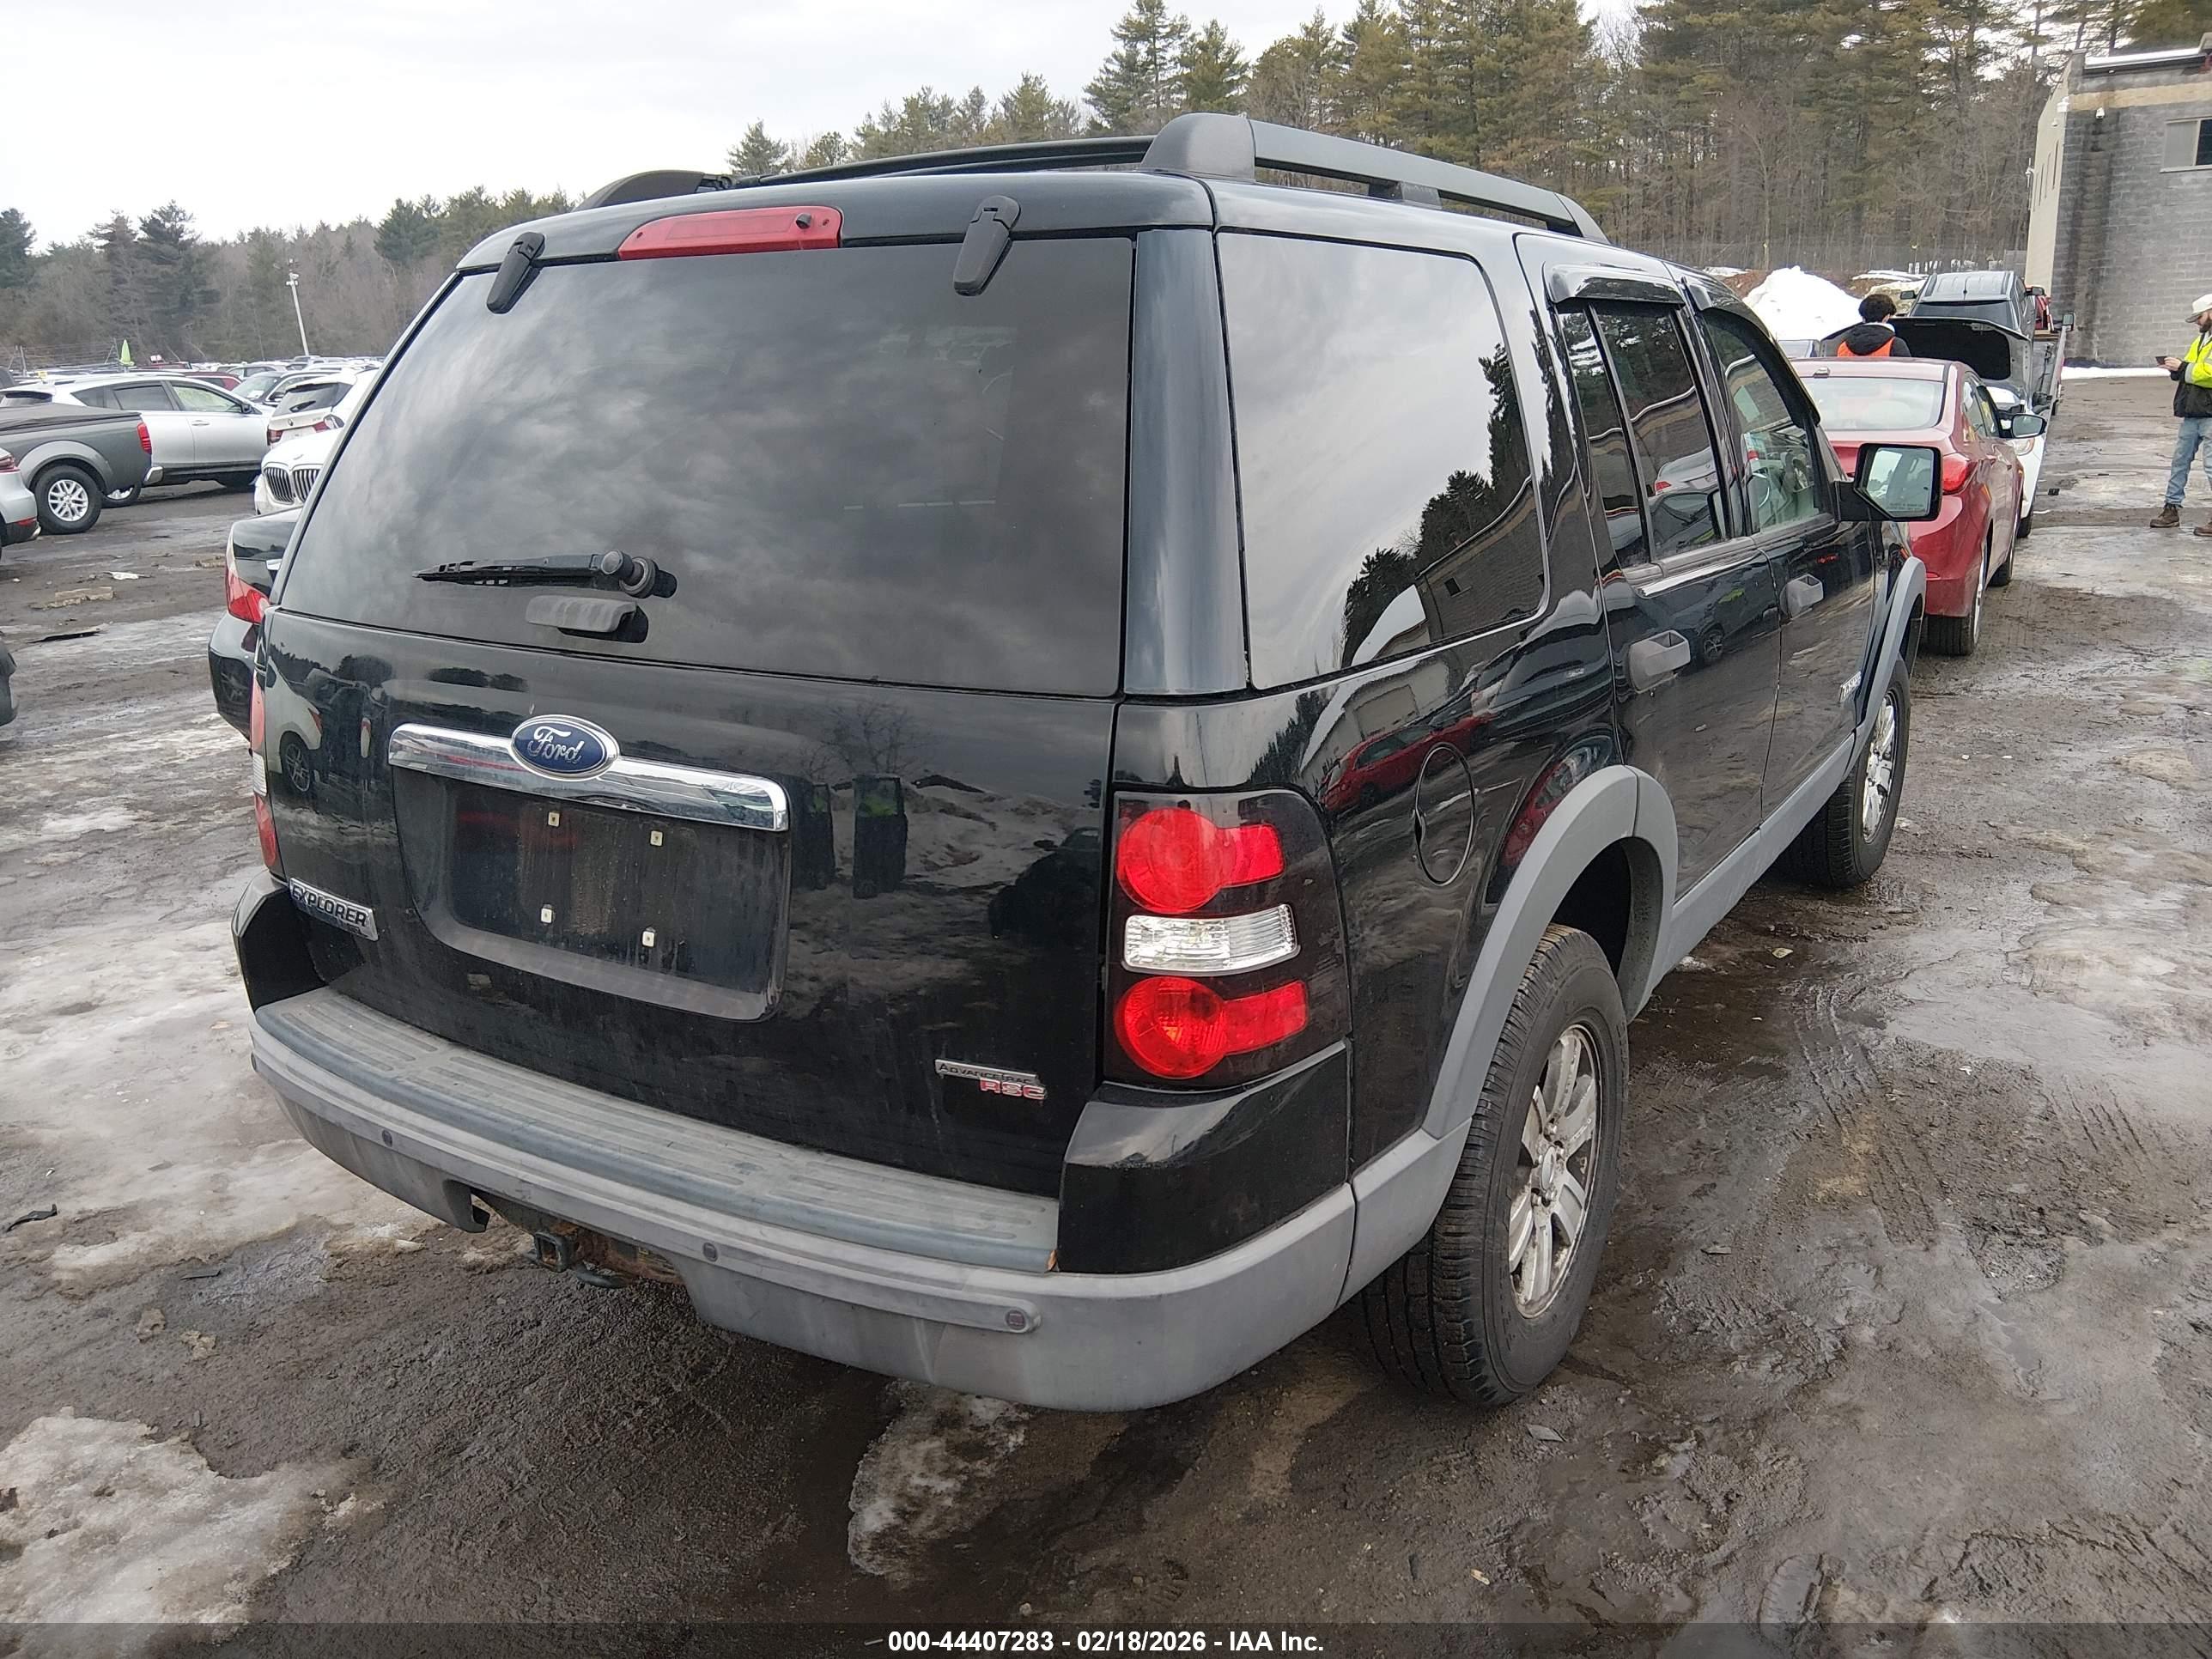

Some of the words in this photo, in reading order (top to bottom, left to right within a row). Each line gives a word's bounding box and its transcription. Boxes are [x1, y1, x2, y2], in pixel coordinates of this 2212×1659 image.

[527, 726, 585, 764] Ford
[292, 883, 368, 927] EXPLORER
[980, 1078, 1047, 1100] RSC
